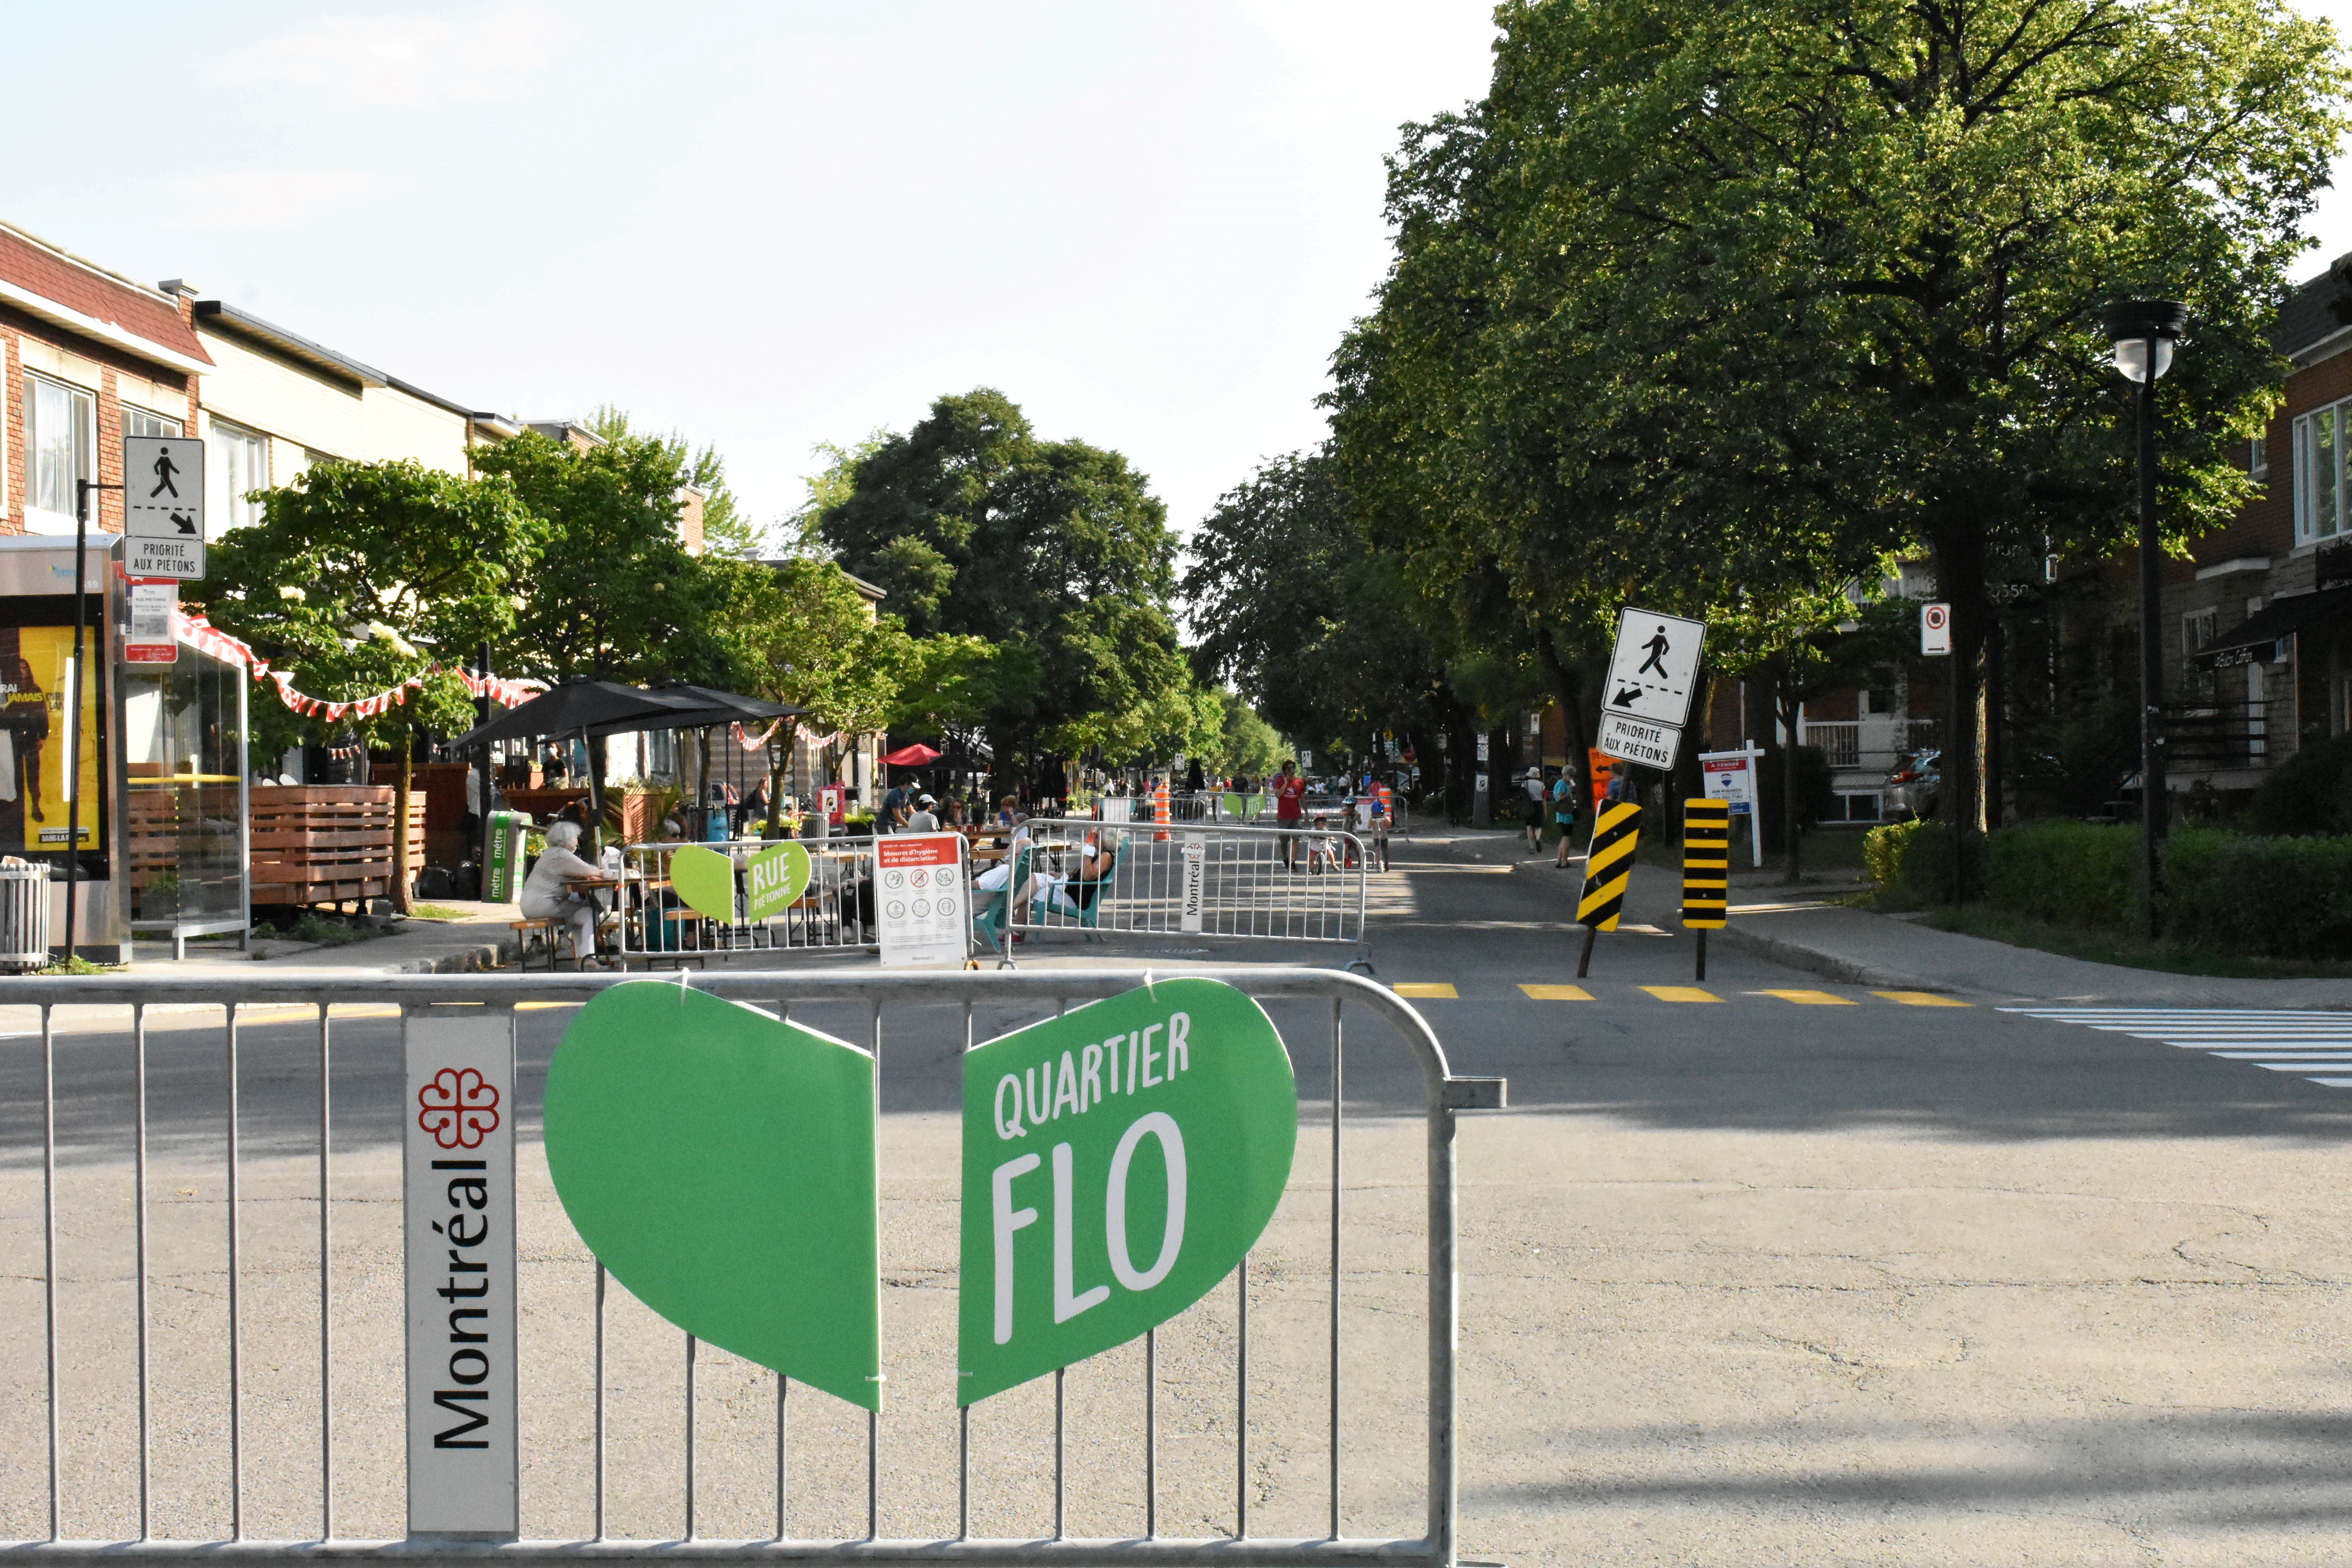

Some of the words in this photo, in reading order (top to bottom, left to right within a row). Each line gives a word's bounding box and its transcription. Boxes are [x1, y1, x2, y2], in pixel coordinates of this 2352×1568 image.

[144, 543, 184, 557] PRIORITÉ
[134, 558, 152, 570] AUX
[157, 558, 195, 572] PIÉTONS
[1616, 722, 1662, 743] PRIORITÉ
[1604, 737, 1621, 751] AUX
[1623, 741, 1668, 762] PIÉTONS
[1248, 802, 1260, 815] FLO
[494, 829, 503, 858] métro
[491, 868, 501, 897] métro
[753, 852, 791, 896] RUE
[1187, 860, 1199, 916] Montréal
[754, 883, 791, 911] PIÉTONNE
[994, 1011, 1191, 1140] QUARTIER
[992, 1111, 1187, 1344] FLO
[432, 1160, 489, 1449] Montréal
